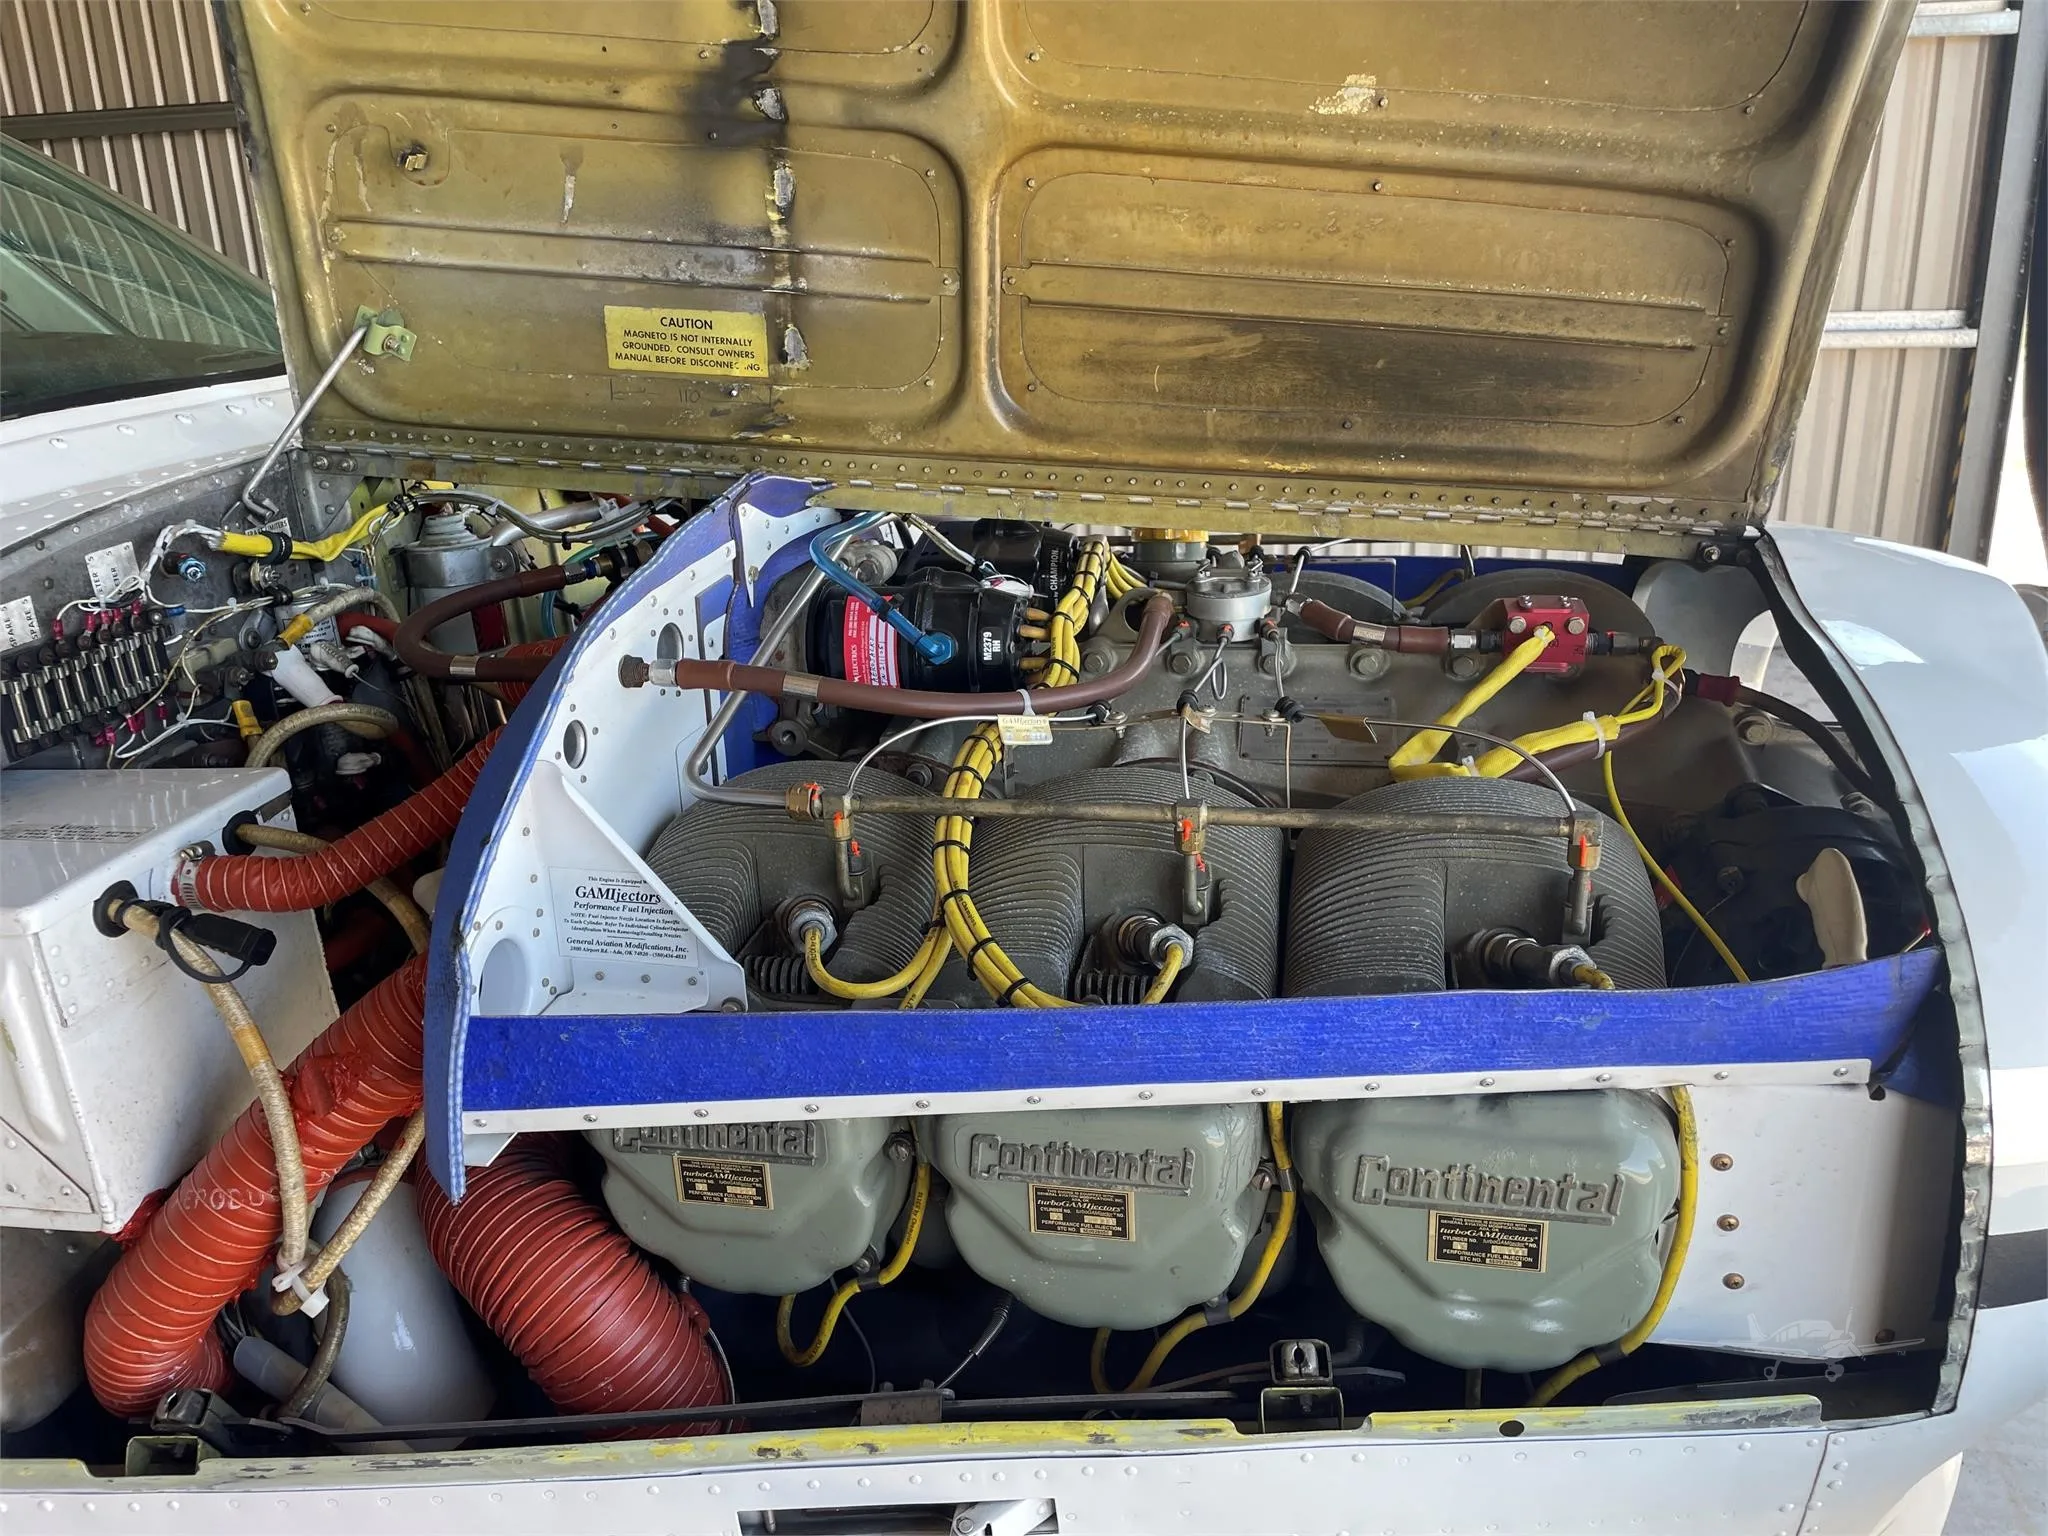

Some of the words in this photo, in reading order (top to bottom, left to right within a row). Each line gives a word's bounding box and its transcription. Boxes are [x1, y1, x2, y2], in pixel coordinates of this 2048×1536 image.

[660, 317, 712, 330] CAUTION
[624, 330, 667, 340] MAGNETO
[670, 333, 678, 341] IS
[680, 334, 698, 343] NOT
[702, 336, 752, 347] INTERNALLY
[622, 342, 672, 353] GROUNDED.
[677, 346, 714, 356] CONSULT
[718, 349, 755, 359] OWNERS
[615, 353, 652, 362] MANUAL
[655, 356, 686, 365] BEFORE
[690, 359, 763, 371] DISCONNECNG.
[1050, 549, 1059, 590] CHAMPION
[983, 631, 992, 660] M2379
[992, 640, 1001, 652] RH
[575, 885, 661, 903] GAMIjectors
[574, 901, 620, 911] Performance
[641, 906, 673, 915] Injection
[567, 937, 593, 945] General
[625, 941, 674, 952] Modifications,
[675, 945, 689, 953] Inc.
[970, 1133, 1196, 1188] Continental
[1353, 1154, 1626, 1217] Continental
[1443, 1249, 1486, 1258] PERFORMANCE
[1503, 1254, 1533, 1262] INJECTION
